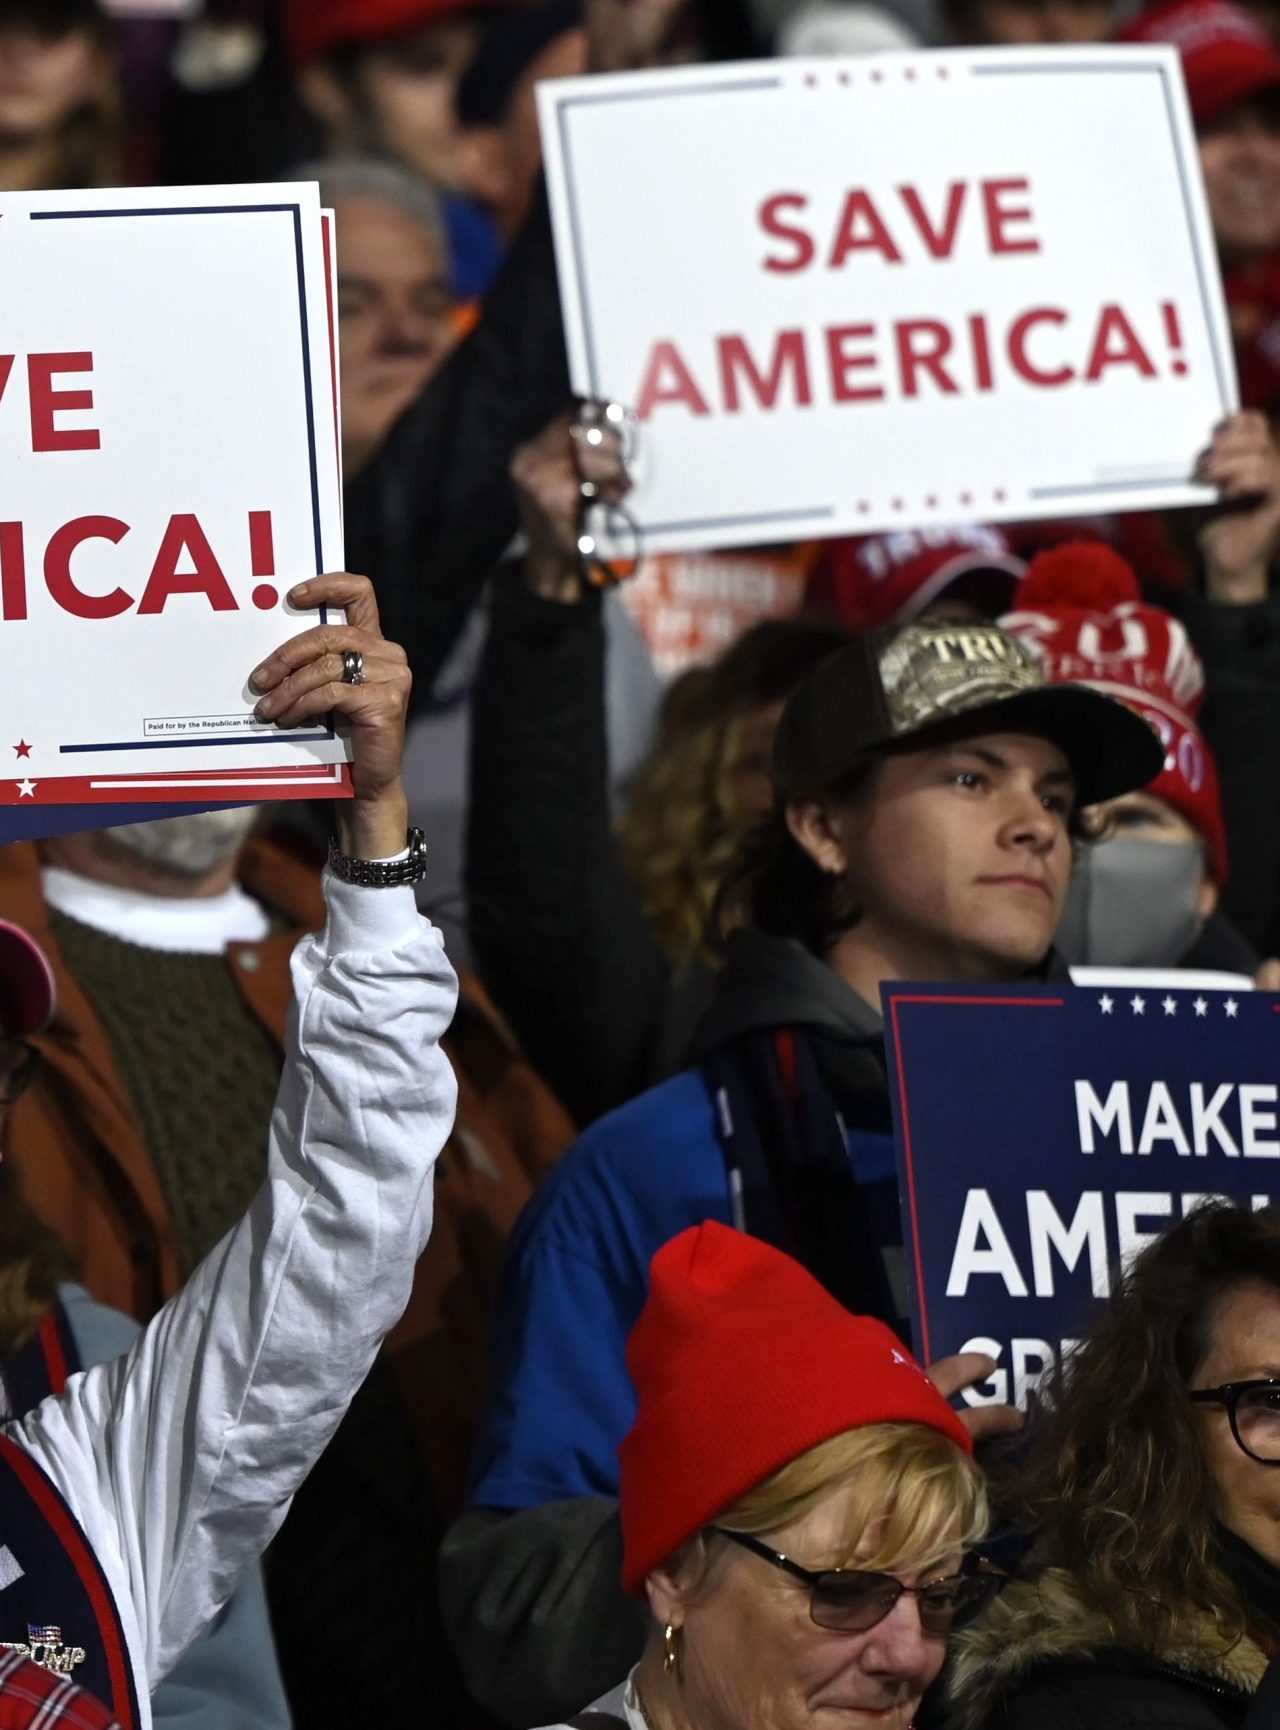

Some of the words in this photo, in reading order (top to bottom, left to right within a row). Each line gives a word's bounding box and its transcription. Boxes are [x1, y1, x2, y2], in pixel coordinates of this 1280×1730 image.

[757, 177, 1042, 275] SAVE
[635, 300, 1191, 421] AMERICA!
[148, 722, 164, 730] Paid
[177, 722, 186, 730] by
[188, 720, 201, 728] the
[202, 719, 241, 728] Republican
[1074, 1079, 1280, 1159] MAKE
